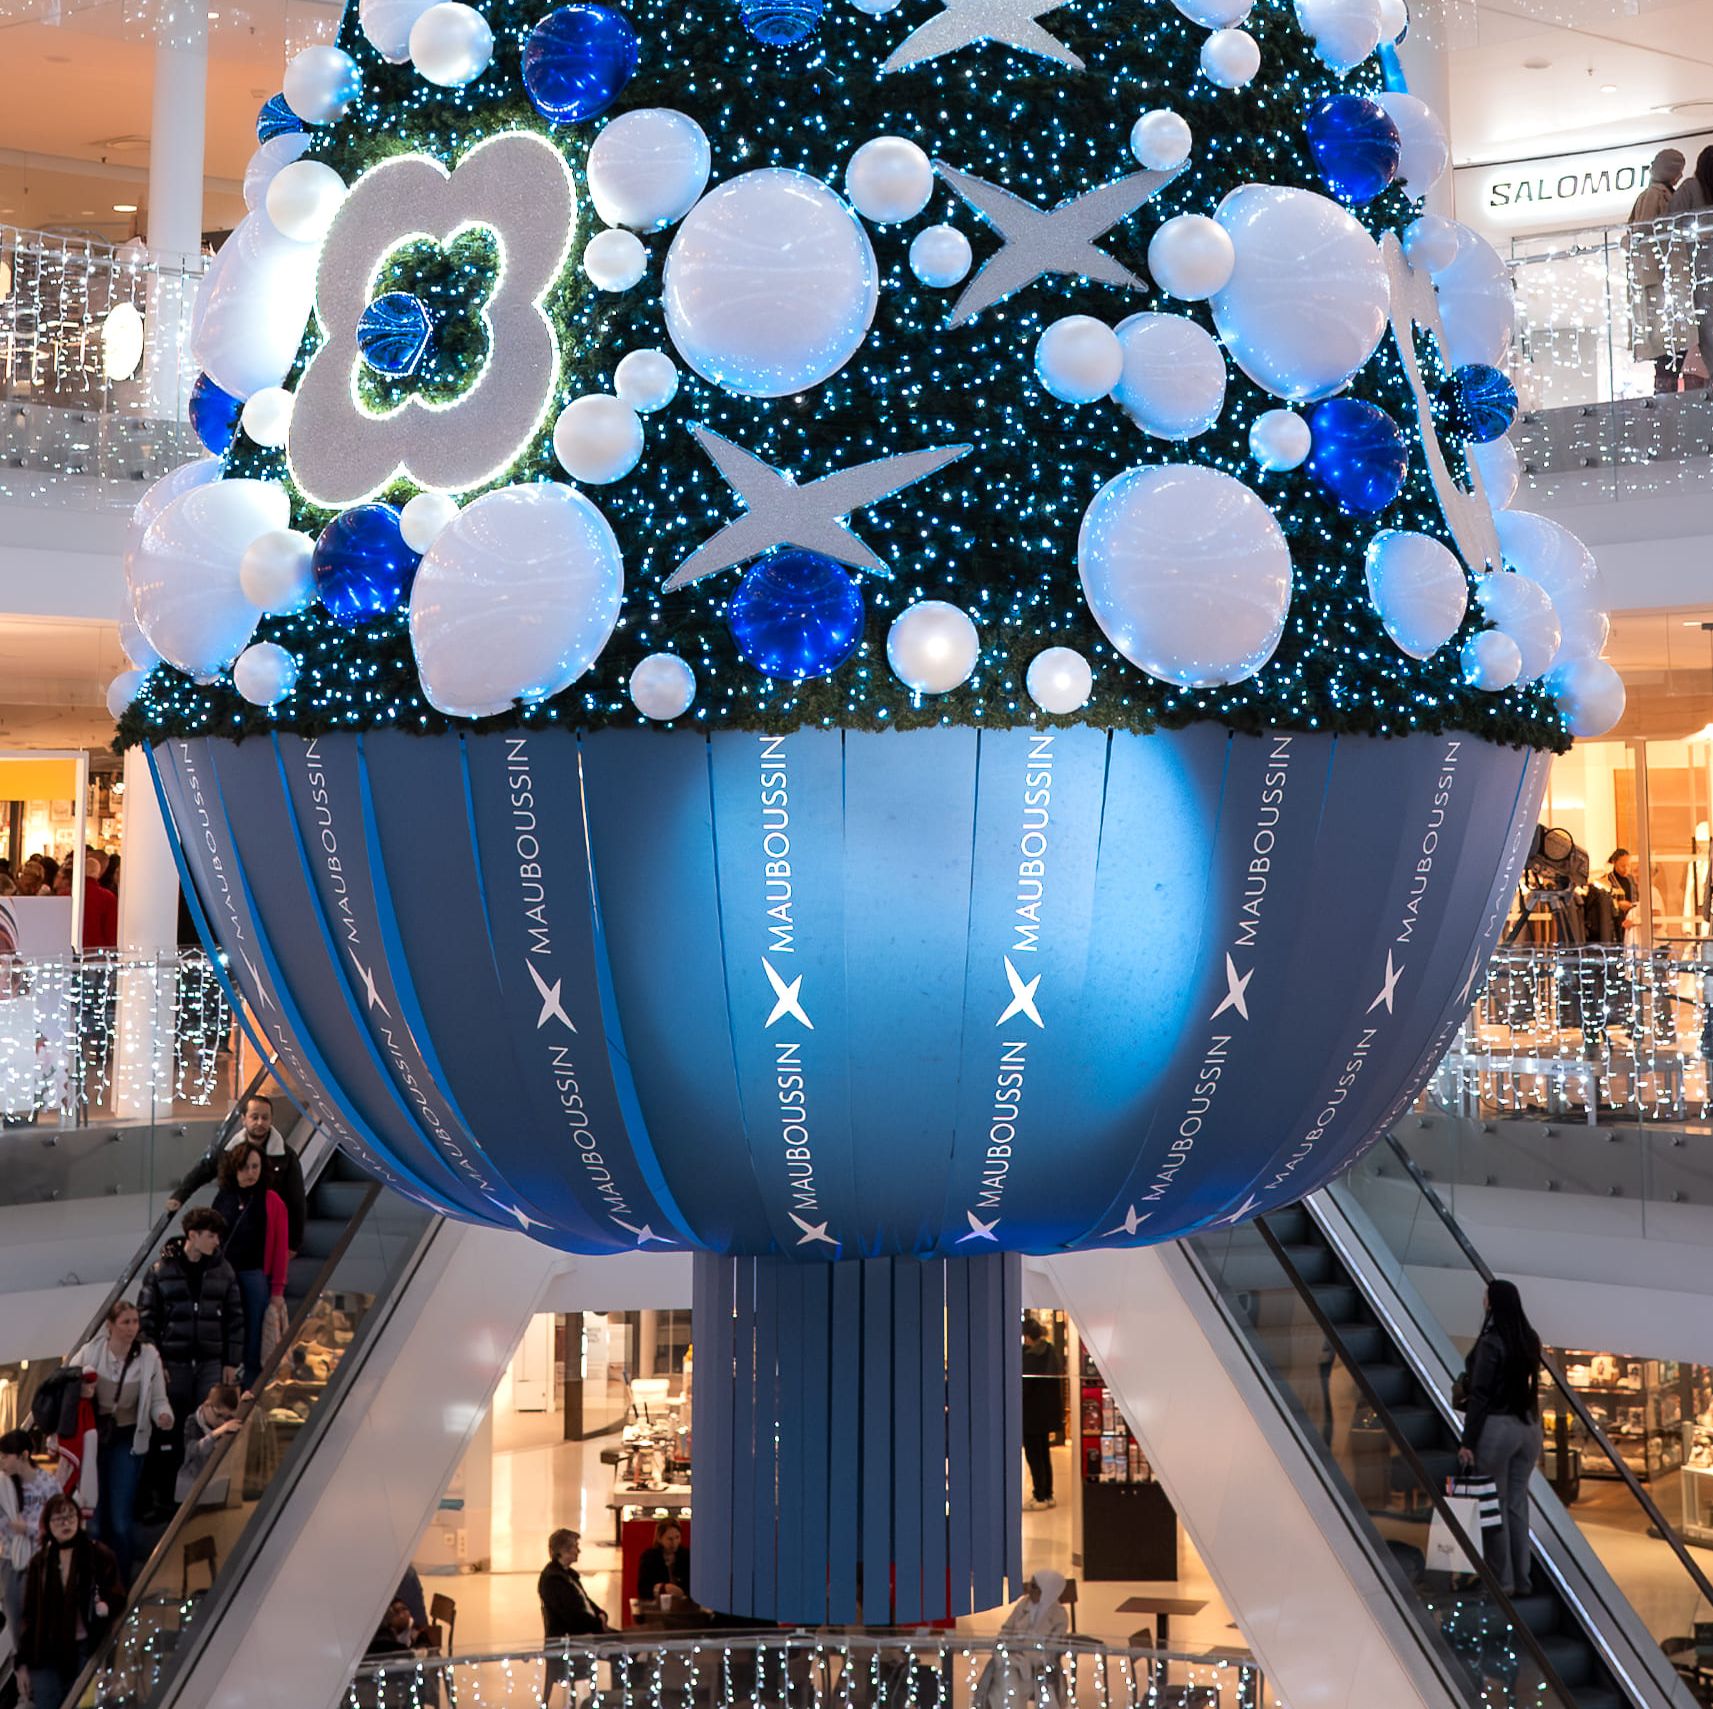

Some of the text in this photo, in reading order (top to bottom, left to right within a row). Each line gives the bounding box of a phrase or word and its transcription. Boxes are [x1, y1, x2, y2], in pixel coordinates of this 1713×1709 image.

[306, 738, 361, 943] MAUBOUSSIN
[505, 739, 552, 955] MAUBOUSSIN
[760, 735, 796, 953] MAUBOUSSIN
[1013, 734, 1054, 951] MAUBOUSSIN
[1235, 736, 1292, 946] MAUBOUSSIN
[1397, 740, 1461, 942] MAUBOUSSIN
[382, 1028, 495, 1192] MAUBOUSSIN
[550, 1045, 628, 1213] MAUBOUSSIN
[776, 1042, 818, 1211] MAUBOUSSIN
[978, 1041, 1025, 1208] MAUBOUSSIN
[1142, 1034, 1231, 1201] MAUBOUSSIN
[1265, 1028, 1377, 1189] MAUBOUSSIN
